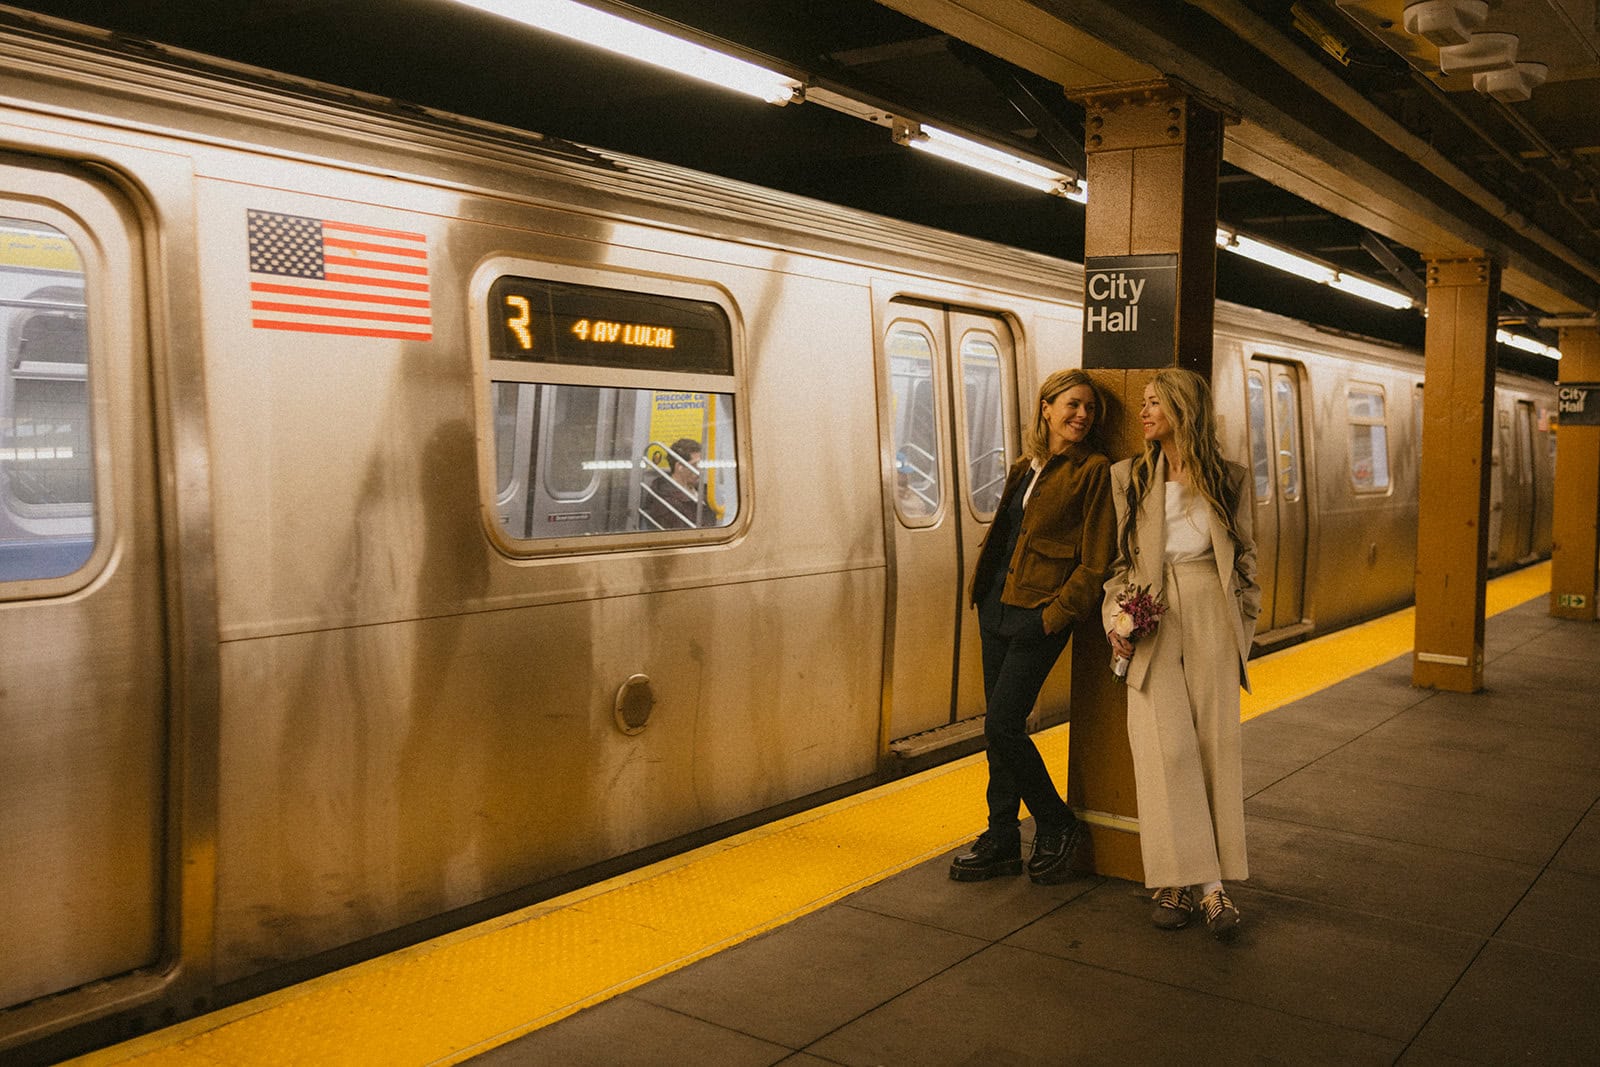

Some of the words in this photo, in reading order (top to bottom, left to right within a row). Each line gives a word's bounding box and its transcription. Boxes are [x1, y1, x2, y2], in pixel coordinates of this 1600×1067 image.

[1088, 273, 1146, 305] City
[1087, 305, 1138, 332] Hall
[572, 319, 590, 341] 4
[592, 320, 620, 343] AV
[1559, 388, 1587, 401] City
[1559, 401, 1584, 412] Hall
